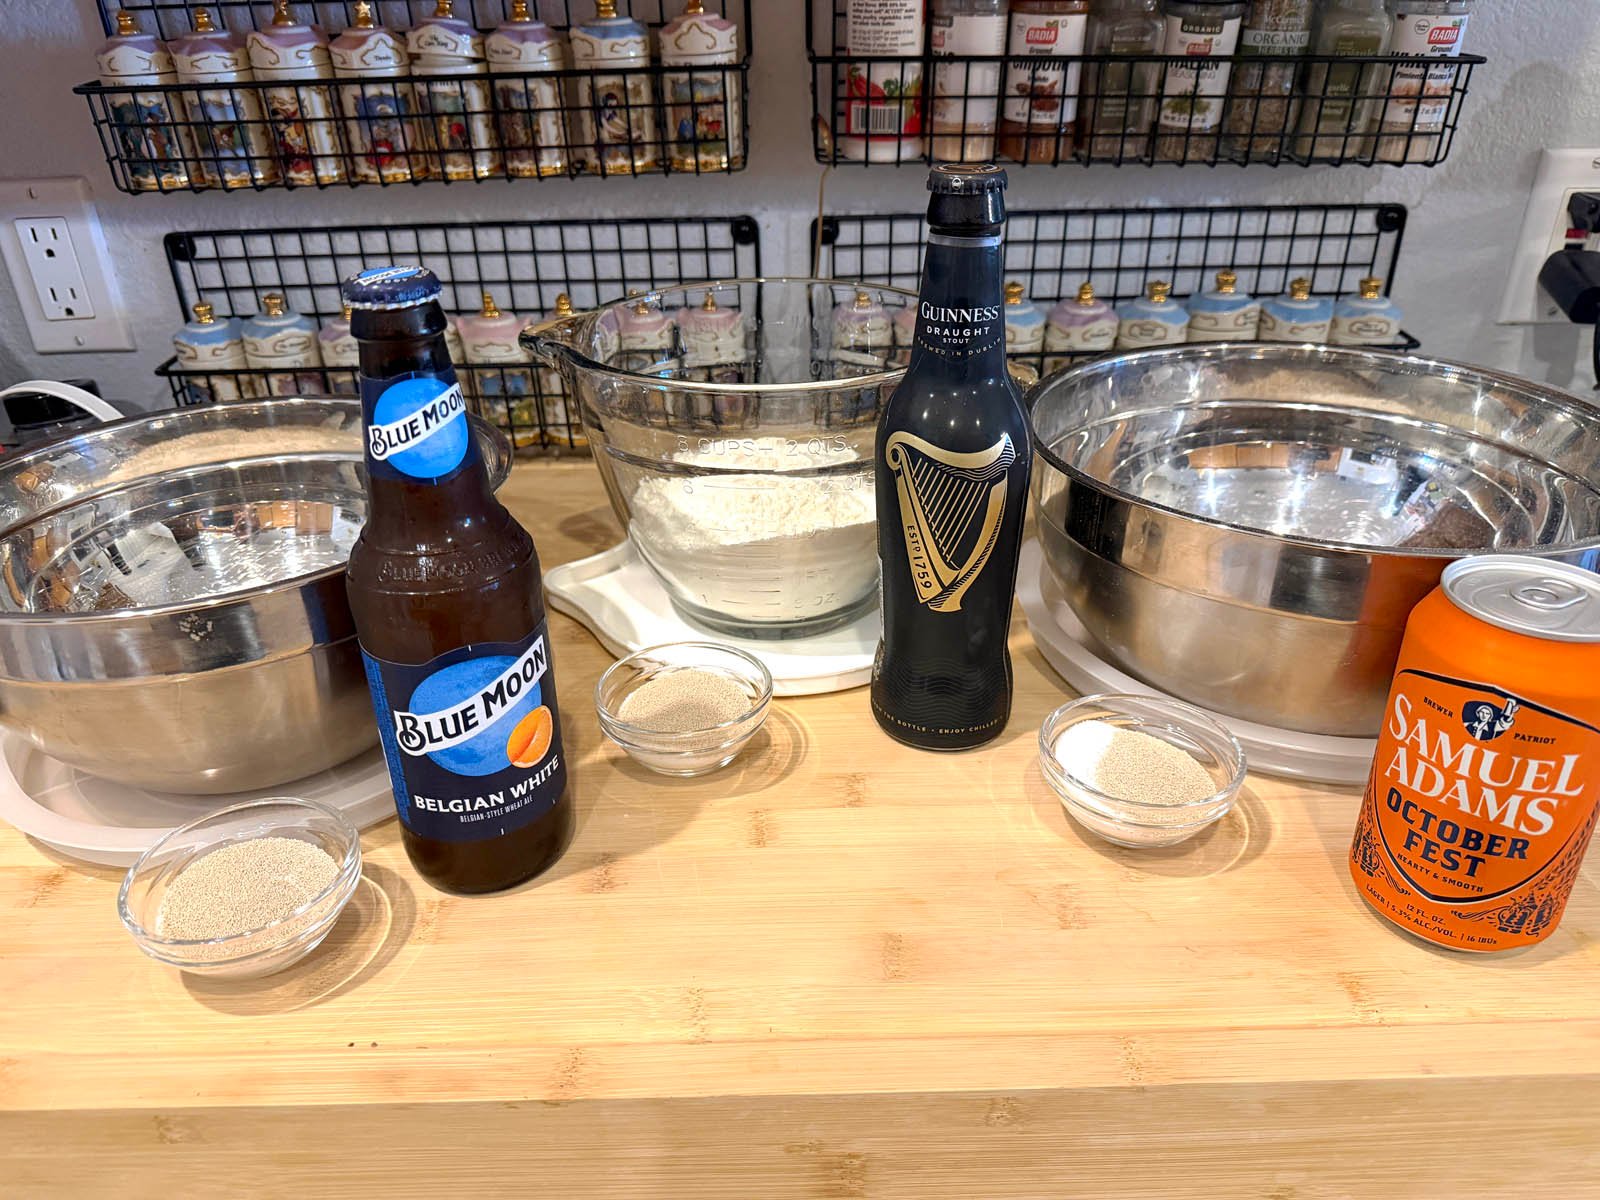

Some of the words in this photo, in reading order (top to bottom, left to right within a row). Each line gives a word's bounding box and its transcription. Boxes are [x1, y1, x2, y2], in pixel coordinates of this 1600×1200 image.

[1028, 30, 1056, 41] BADIA
[1183, 25, 1221, 33] ORGANIC
[1253, 32, 1306, 45] ORGANIC
[1431, 28, 1458, 41] BADIA
[1430, 45, 1454, 53] Ground
[921, 301, 1000, 323] GUINNESS
[926, 325, 990, 337] DRAUGHT
[371, 418, 421, 457] BLUE
[421, 389, 465, 431] MOON
[676, 435, 689, 452] 8
[697, 438, 754, 457] CUPS
[785, 439, 798, 457] 2
[913, 556, 932, 589] 1759
[399, 703, 479, 751] BLUE
[481, 644, 545, 718] MOON
[897, 719, 927, 732] BOTTLE
[1423, 696, 1454, 719] BREWER
[1513, 732, 1557, 745] PATRIOT
[1388, 693, 1585, 797] SAMUEL
[413, 790, 505, 813] BELGIAN
[509, 754, 560, 799] WHITE
[1384, 747, 1559, 836] ADAMS
[459, 809, 504, 823] BELGIAN-STYLE
[505, 801, 523, 814] WHEAT
[524, 795, 533, 806] ALE
[1386, 786, 1530, 860] OCTOBER
[1402, 828, 1486, 878] FEST
[1397, 853, 1430, 875] HEARTY
[1442, 876, 1484, 893] SMOOTH
[1366, 883, 1386, 904] LAGER
[1391, 904, 1412, 921] 5.3%
[1413, 917, 1457, 939] ALC./VOL.
[1466, 935, 1476, 943] 16
[1406, 903, 1415, 912] 12
